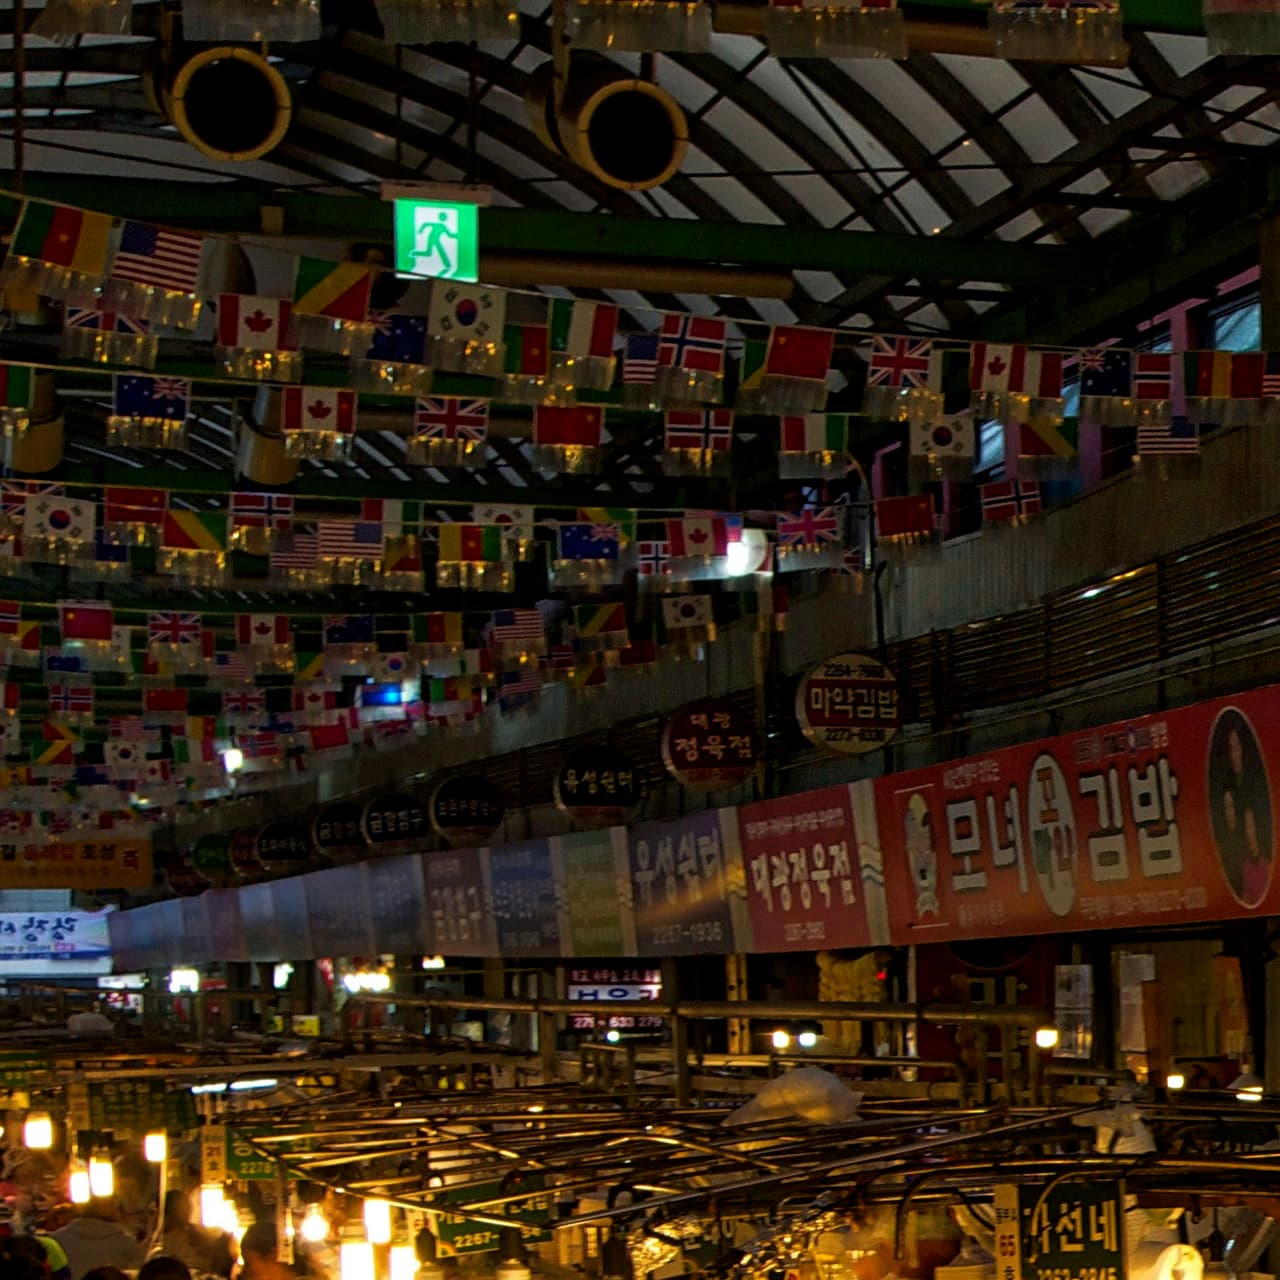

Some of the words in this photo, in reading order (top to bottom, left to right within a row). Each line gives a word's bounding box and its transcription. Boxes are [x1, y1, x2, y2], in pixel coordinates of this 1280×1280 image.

[809, 687, 900, 719] 마약김밥
[945, 784, 1029, 894] 모녀
[1078, 755, 1180, 884] 김밥
